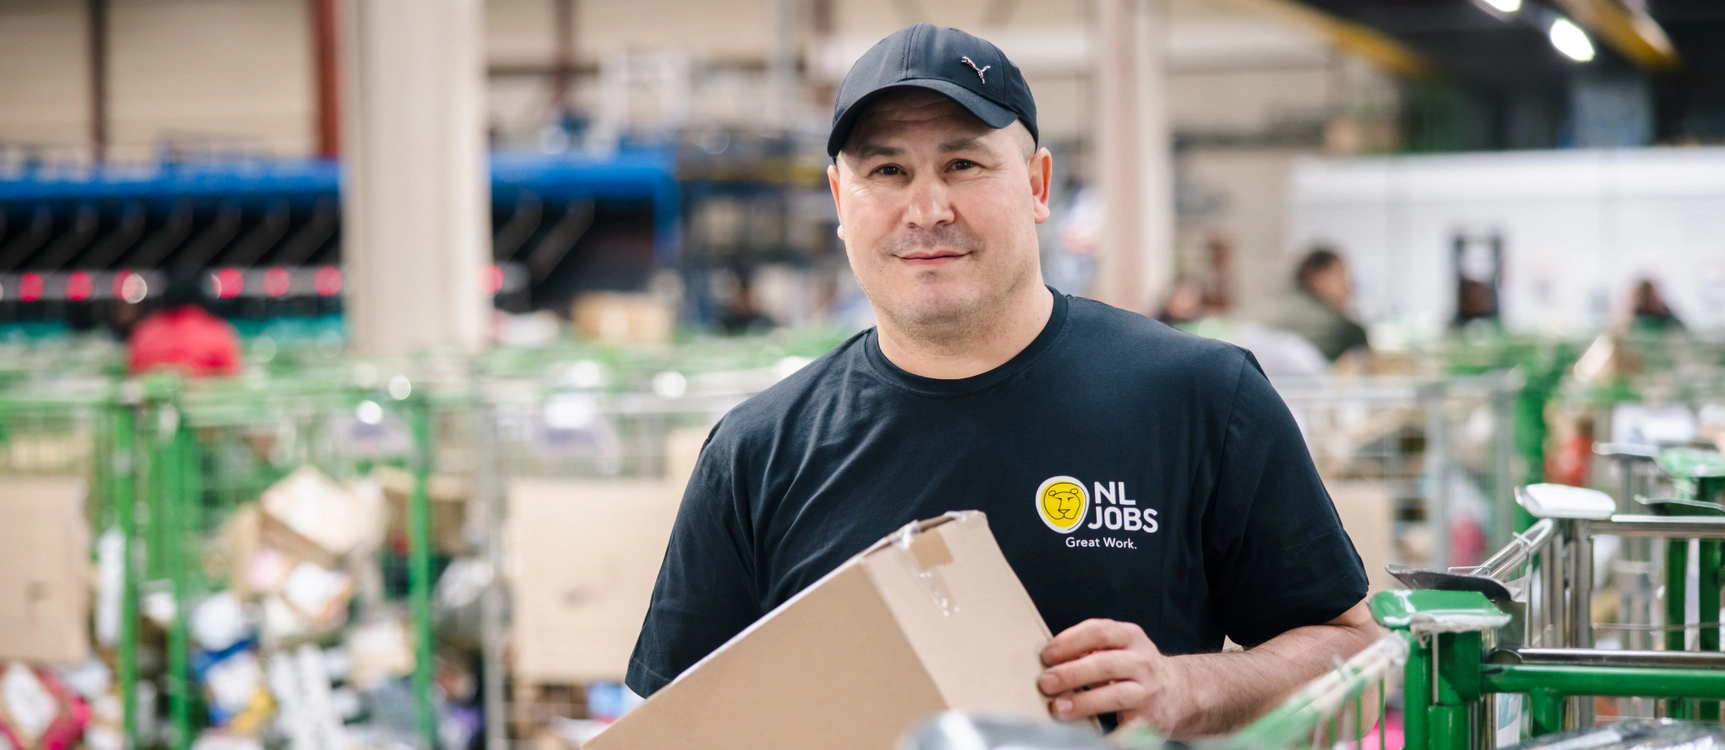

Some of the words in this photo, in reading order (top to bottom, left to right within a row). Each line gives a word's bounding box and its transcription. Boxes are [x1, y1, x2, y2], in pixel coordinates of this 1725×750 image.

[1094, 481, 1136, 505] NL
[1087, 506, 1159, 533] JOBS
[1065, 537, 1100, 548] Great
[1103, 537, 1137, 549] Work.
